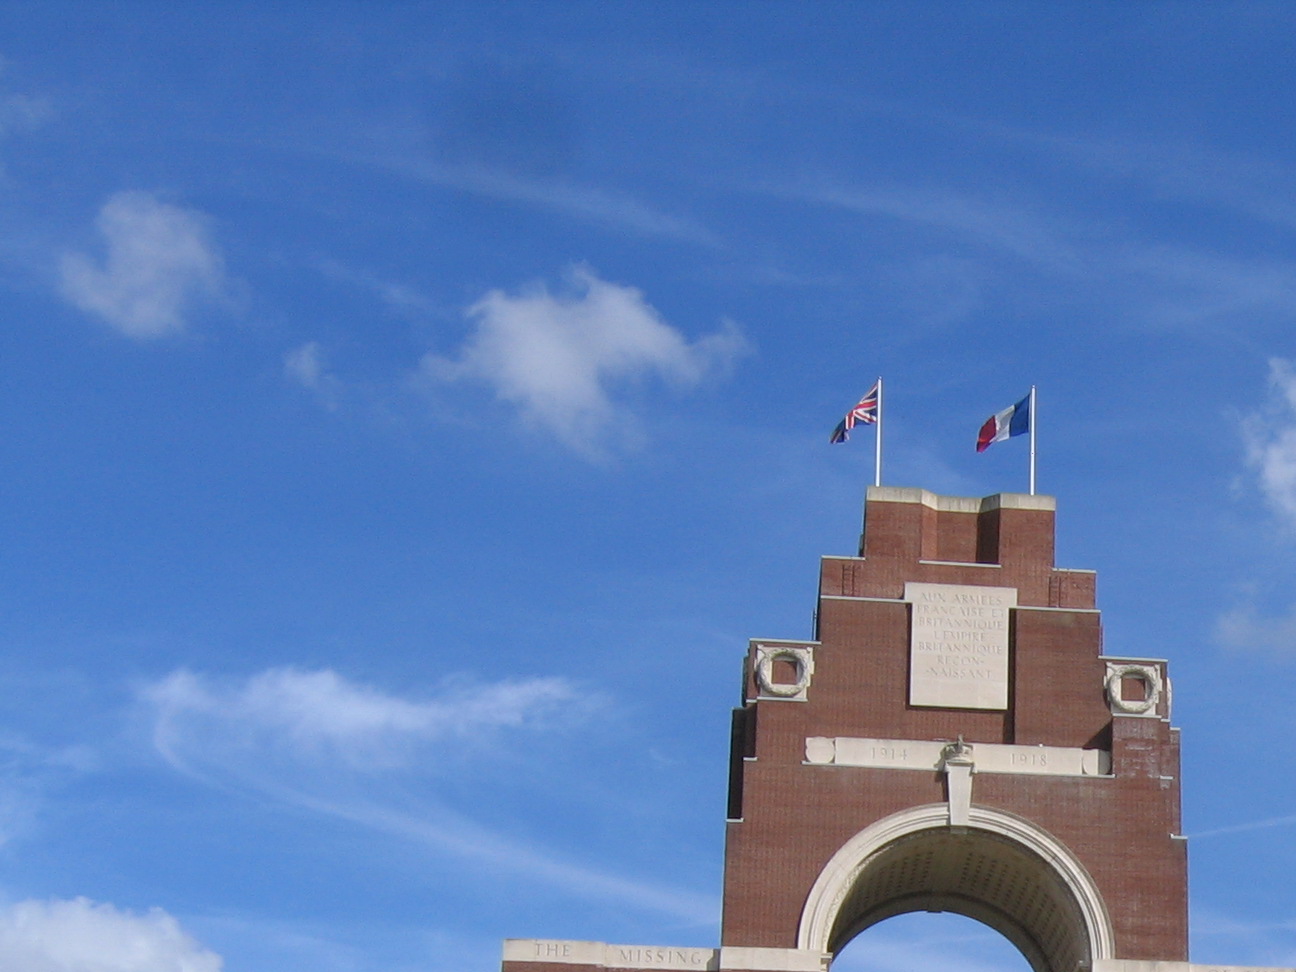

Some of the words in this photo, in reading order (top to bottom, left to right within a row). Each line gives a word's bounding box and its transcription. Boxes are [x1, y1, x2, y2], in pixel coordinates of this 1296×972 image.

[920, 591, 946, 603] AUX
[991, 608, 1004, 618] ET
[918, 616, 1004, 631] BRITANNIQUE
[918, 641, 1003, 656] BRITANNIQUE
[871, 747, 908, 761] 1914
[1011, 753, 1048, 767] 1918
[535, 943, 571, 957] THE
[620, 949, 702, 965] MISSING
